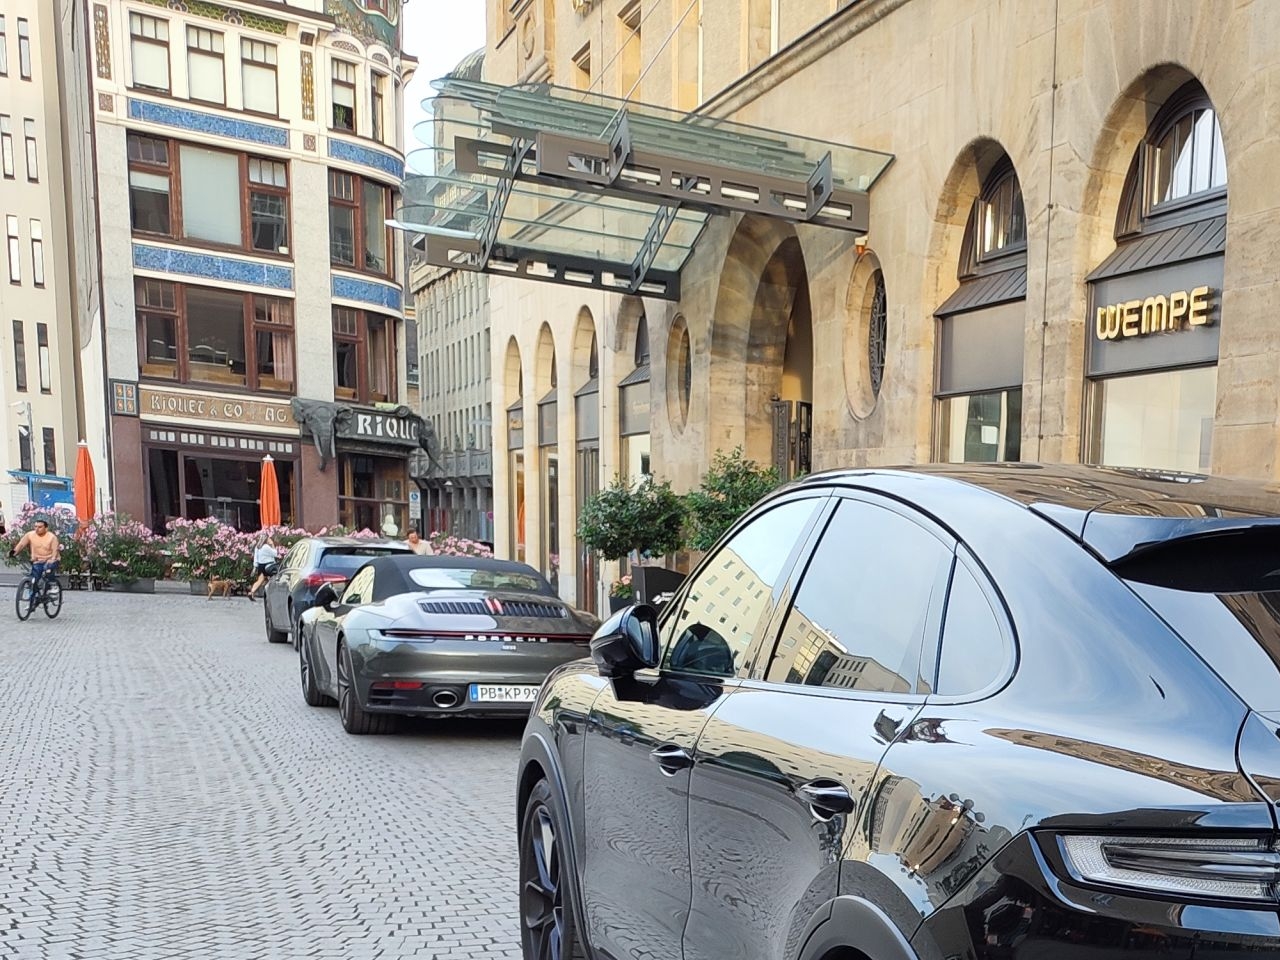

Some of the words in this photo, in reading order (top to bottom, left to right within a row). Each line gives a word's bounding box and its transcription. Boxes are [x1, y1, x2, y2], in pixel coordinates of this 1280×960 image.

[1096, 285, 1212, 341] WEMPE
[480, 687, 497, 700] PB
[504, 687, 521, 700] KP
